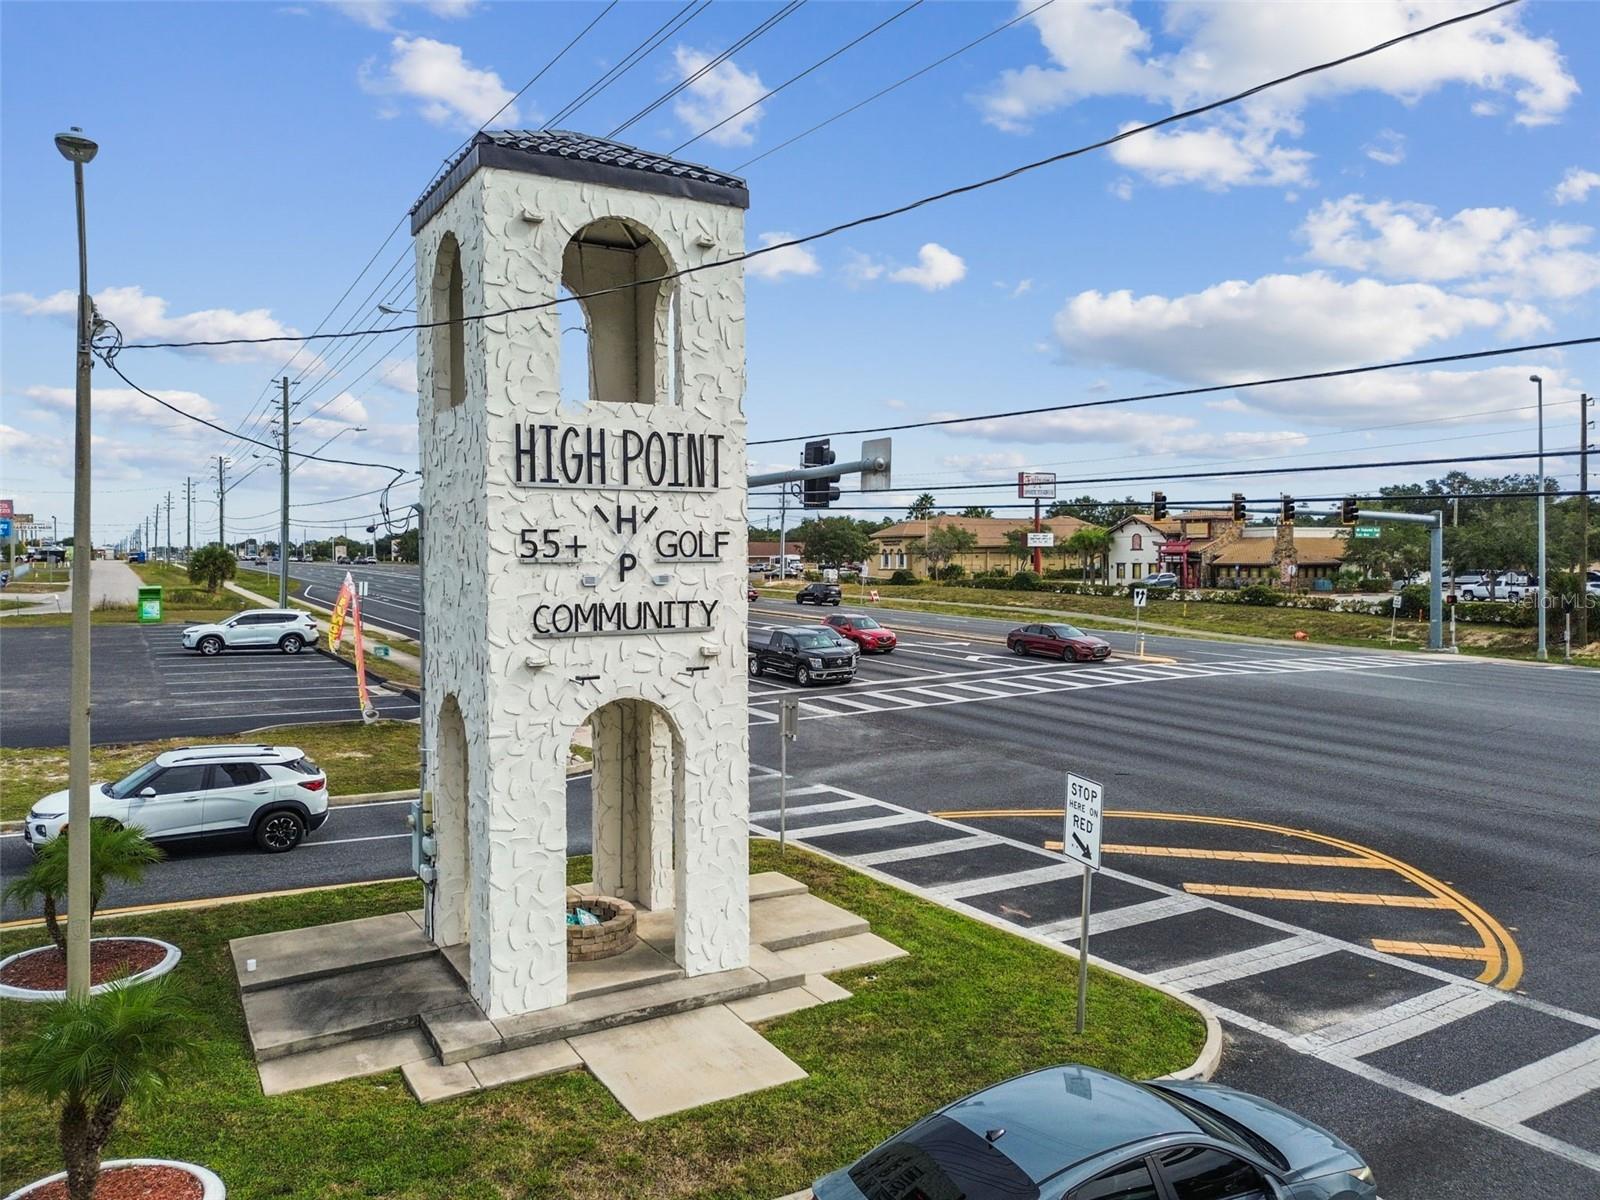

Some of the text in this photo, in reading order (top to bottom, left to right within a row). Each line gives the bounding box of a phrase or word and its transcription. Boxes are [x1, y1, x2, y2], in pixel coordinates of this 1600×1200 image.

[515, 423, 725, 488] HIGH POINT
[616, 504, 637, 534] H
[520, 528, 730, 559] 55+ GOLF
[619, 553, 637, 582] P
[532, 599, 719, 634] COMMUNITY
[1071, 782, 1097, 803] STOP
[1069, 800, 1098, 818] HERE ON
[1073, 814, 1094, 834] RED
